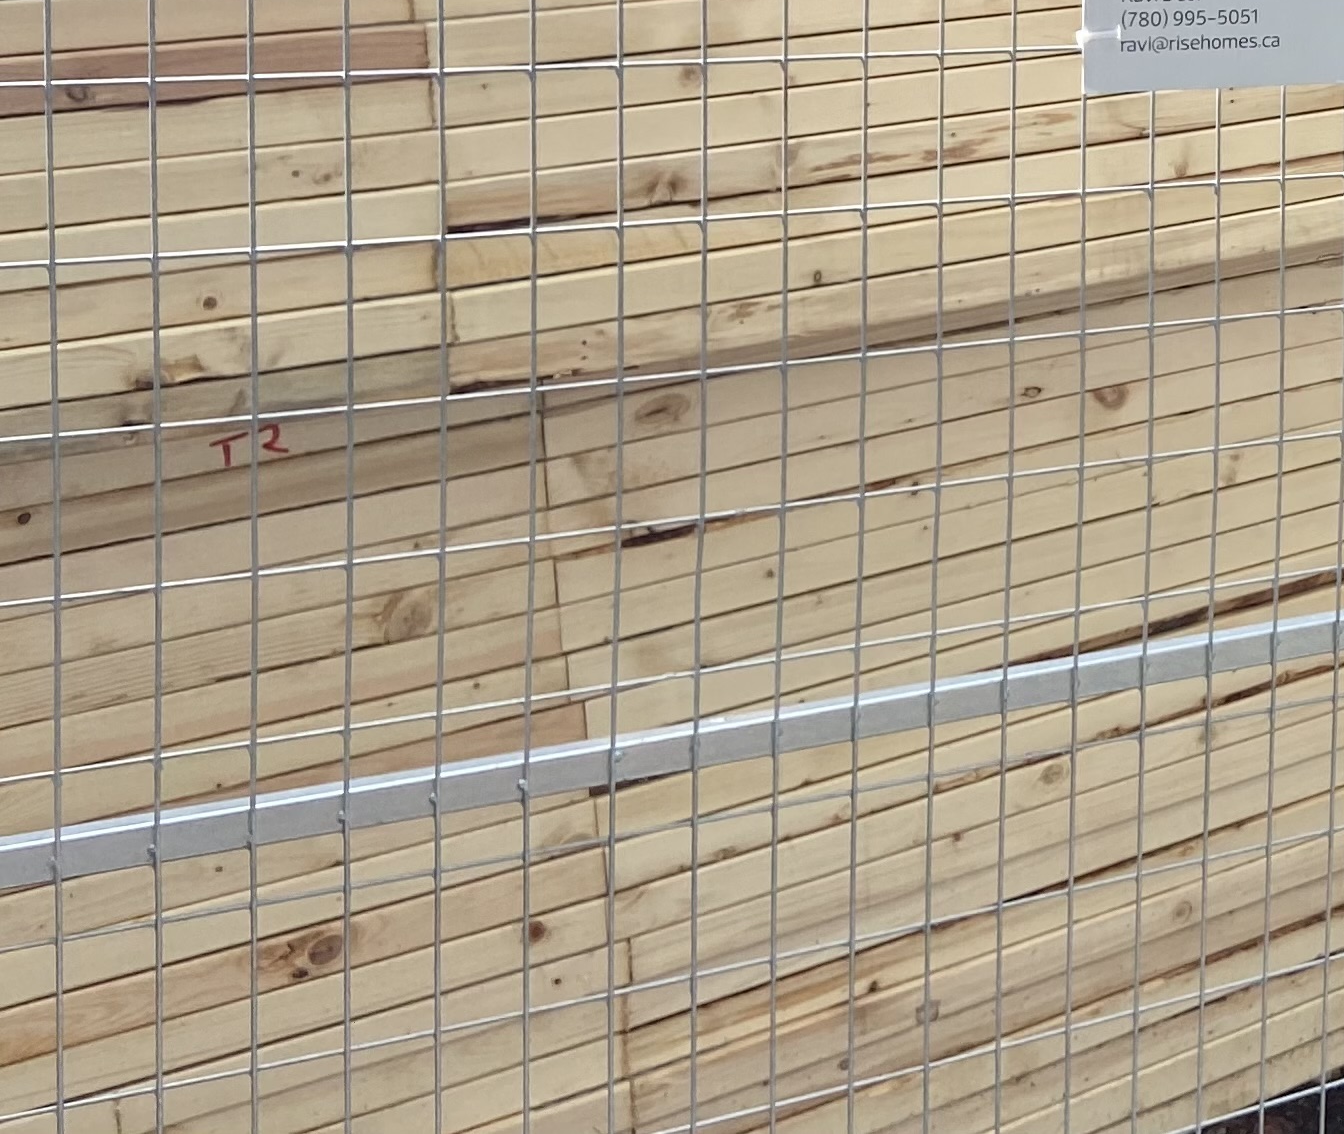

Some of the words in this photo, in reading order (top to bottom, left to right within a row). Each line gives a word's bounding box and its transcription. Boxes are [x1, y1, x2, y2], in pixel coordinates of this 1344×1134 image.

[1121, 9, 1168, 30] (780)
[1173, 8, 1259, 27] 995-5051
[1120, 34, 1280, 54] ravi@risehomes.ca
